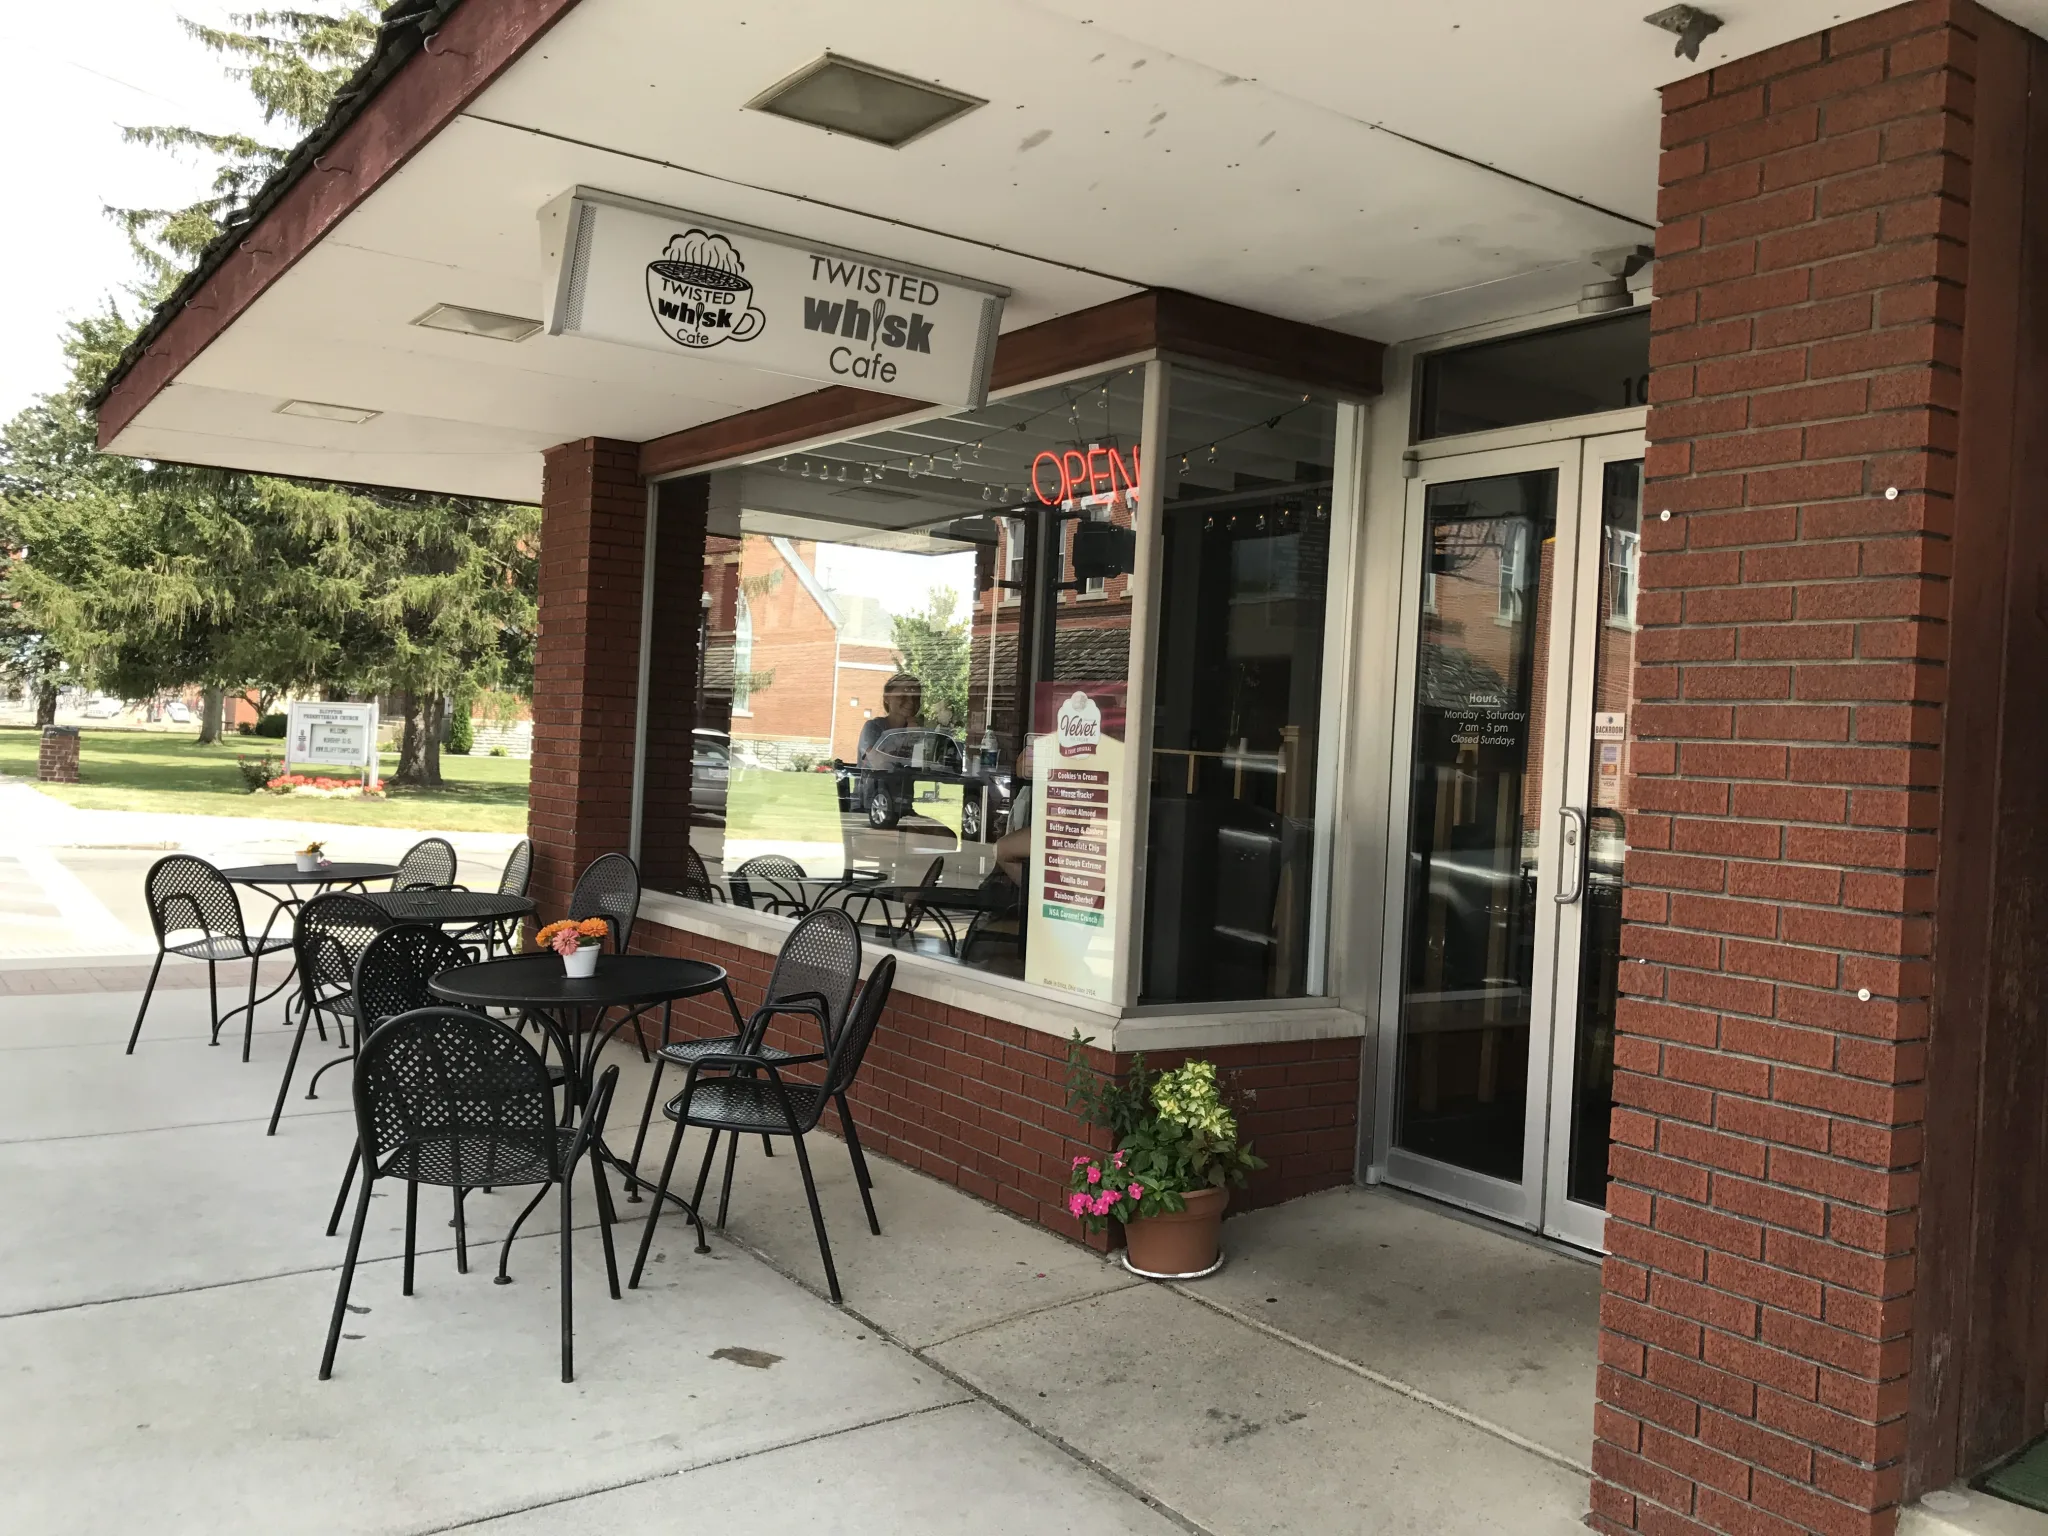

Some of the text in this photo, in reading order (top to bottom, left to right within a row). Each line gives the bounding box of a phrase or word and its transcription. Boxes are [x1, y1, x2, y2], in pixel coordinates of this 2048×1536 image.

[809, 255, 940, 306] TWISTED
[661, 278, 736, 305] TWISTED
[658, 299, 734, 332] whisk
[803, 296, 934, 354] whisk
[676, 327, 710, 346] Cafe
[829, 346, 898, 383] Cafe
[1031, 444, 1141, 506] OPEN
[1444, 709, 1480, 721] Monday
[1486, 710, 1525, 721] Saturday
[1060, 714, 1098, 737] Velvet
[1458, 722, 1463, 732] 7
[1464, 724, 1479, 732] am
[1486, 722, 1492, 732] 5
[1493, 724, 1508, 734] pm
[1595, 725, 1624, 734] BACKROOM
[1450, 734, 1516, 746] Closed Sundays
[1057, 771, 1076, 780] Cookies
[1082, 772, 1098, 781] Cream
[1057, 807, 1097, 817] Coconut Almond
[1049, 822, 1064, 832] Butter
[1065, 824, 1079, 833] Pecan
[1052, 839, 1100, 853] Mint Chocolate Chip
[1048, 856, 1102, 870] Cookie Dough Extreme
[1060, 874, 1089, 887] Vanilla Bean
[1054, 890, 1094, 905] Rainbow Sherbet
[1048, 907, 1098, 923] NSA Caramel Crunch
